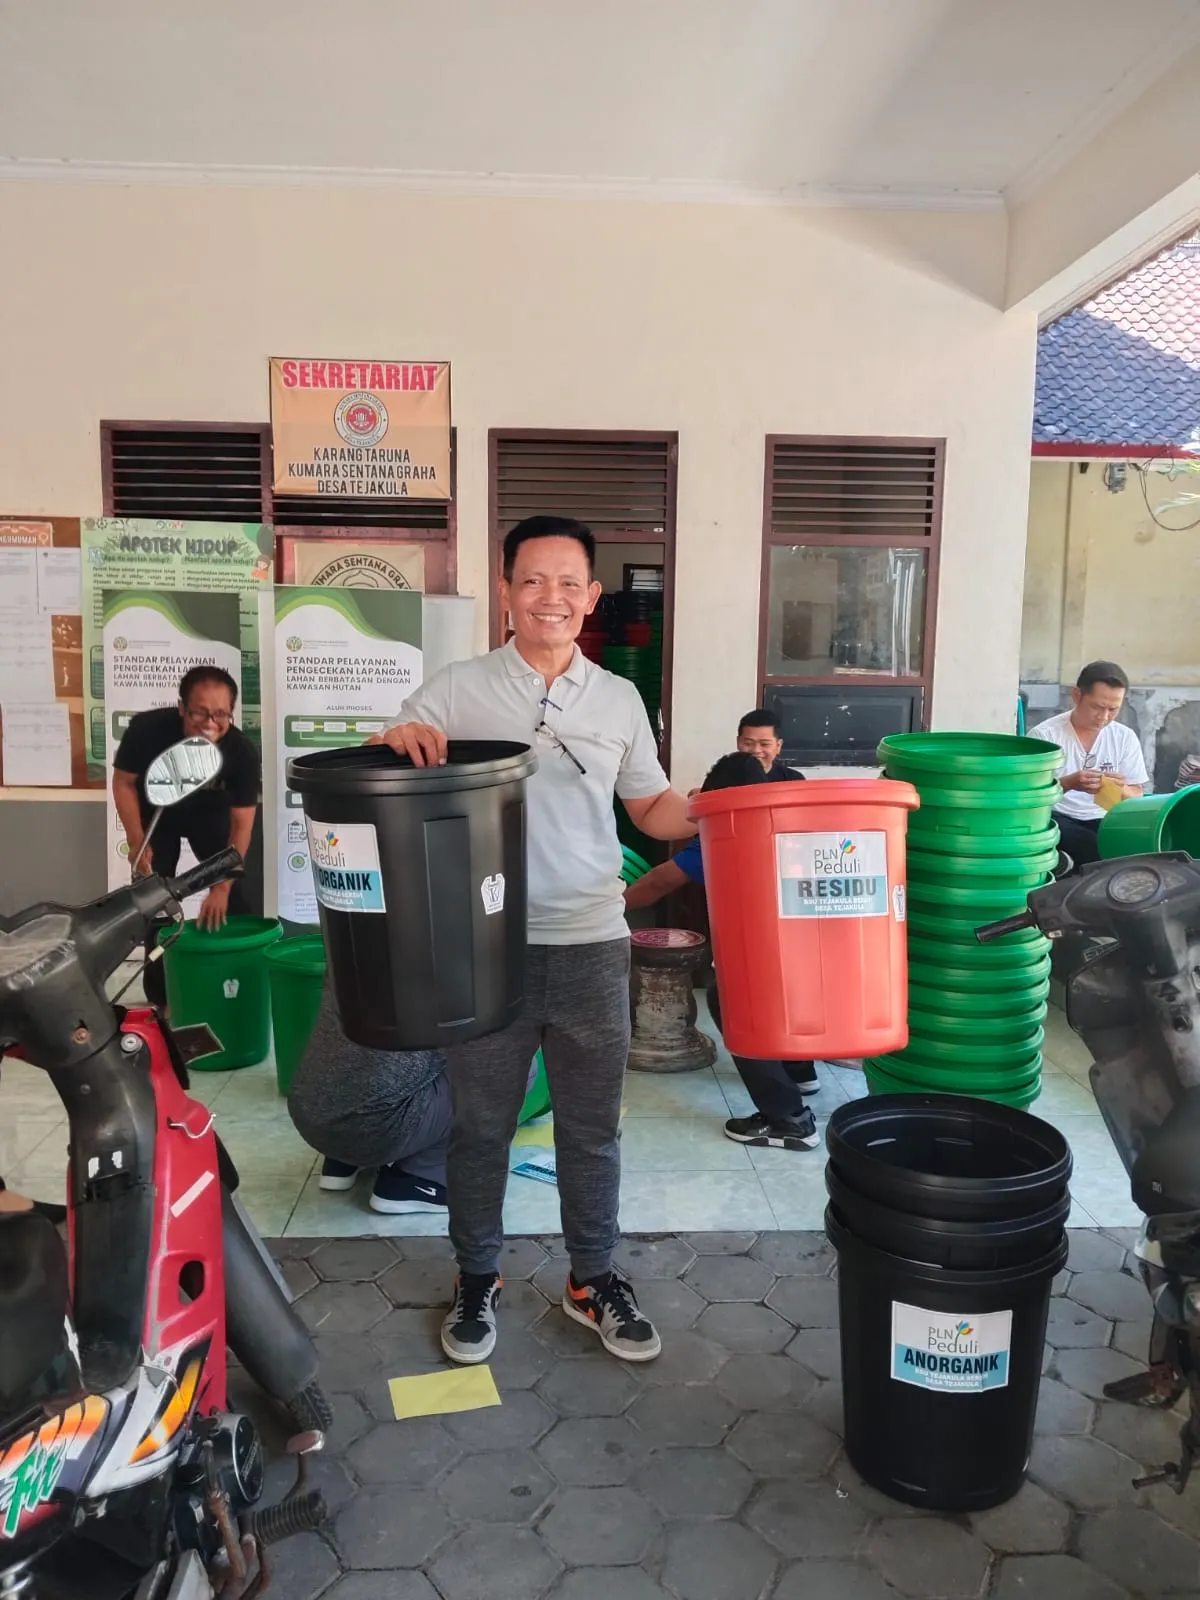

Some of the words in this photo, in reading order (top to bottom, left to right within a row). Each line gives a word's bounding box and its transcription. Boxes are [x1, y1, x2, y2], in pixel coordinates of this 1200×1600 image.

[281, 360, 438, 391] SEKRETARIAT
[313, 448, 363, 462] KARANG
[364, 449, 411, 463] TARUNA
[288, 463, 339, 478] KUMARA
[342, 464, 394, 479] SENTANA
[397, 465, 436, 480] GRAHA
[317, 480, 347, 494] DESA
[349, 480, 408, 495] TEJAKULA
[119, 535, 183, 556] APOTEK
[186, 537, 238, 557] HIDUP
[315, 562, 344, 586] MARA
[343, 557, 387, 574] SENTANA
[113, 655, 158, 664] STANDAR
[159, 655, 216, 665] PELAYANAN
[286, 656, 335, 666] STANDAR
[336, 656, 397, 667] PELAYANAN
[113, 664, 176, 673] PENGECEKAN
[286, 665, 354, 675] PENGECEKAN
[356, 666, 411, 676] LAPANGAN
[113, 680, 155, 688] KAWASAN
[286, 675, 316, 683] LAHAN
[318, 675, 374, 684] BERBATASAN
[376, 676, 411, 685] DENGAN
[286, 683, 331, 691] KAWASAN
[332, 683, 362, 692] HUTAN
[814, 848, 839, 860] PLN
[814, 857, 862, 874] Peduli
[797, 878, 877, 898] RESIDU
[928, 1326, 954, 1340] PLN
[928, 1336, 979, 1354] Peduli
[904, 1348, 999, 1374] ANORGANIK
